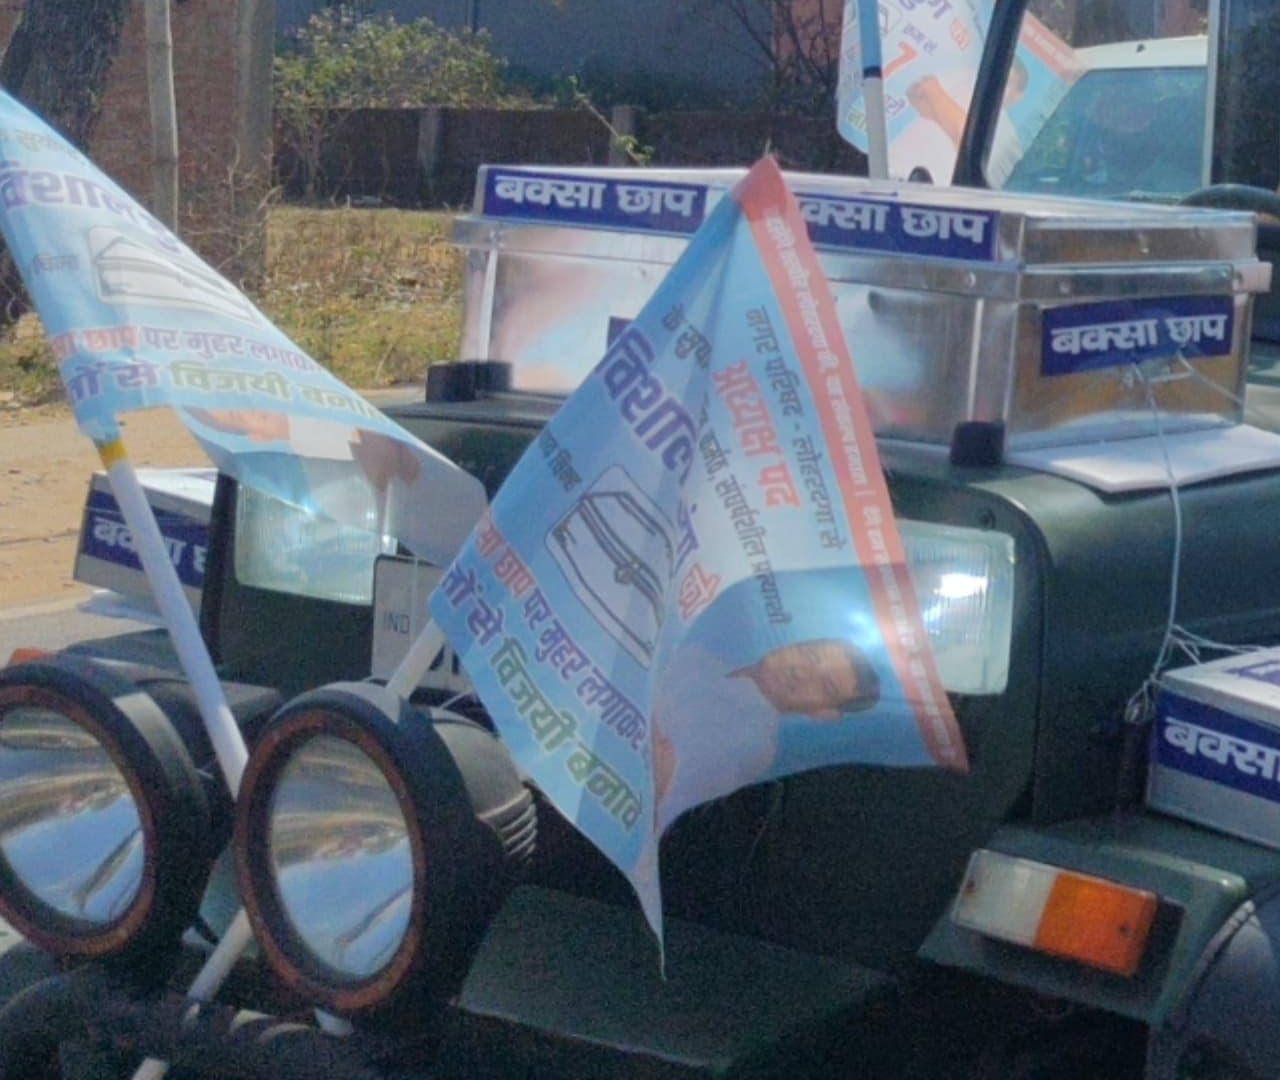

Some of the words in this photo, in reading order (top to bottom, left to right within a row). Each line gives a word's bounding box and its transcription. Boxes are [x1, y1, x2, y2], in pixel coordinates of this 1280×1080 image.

[495, 175, 606, 210] बक्सा
[617, 182, 698, 217] छाप
[800, 199, 890, 233] क्सा
[899, 207, 989, 244] छाप
[1051, 319, 1159, 356] बक्सा
[1164, 314, 1228, 348] छाप
[712, 360, 782, 463] अध्यक्ष
[758, 461, 800, 512] पद
[521, 588, 555, 631] पर
[535, 617, 590, 679] मुहर
[465, 599, 504, 646] से
[488, 635, 578, 752] विजयी
